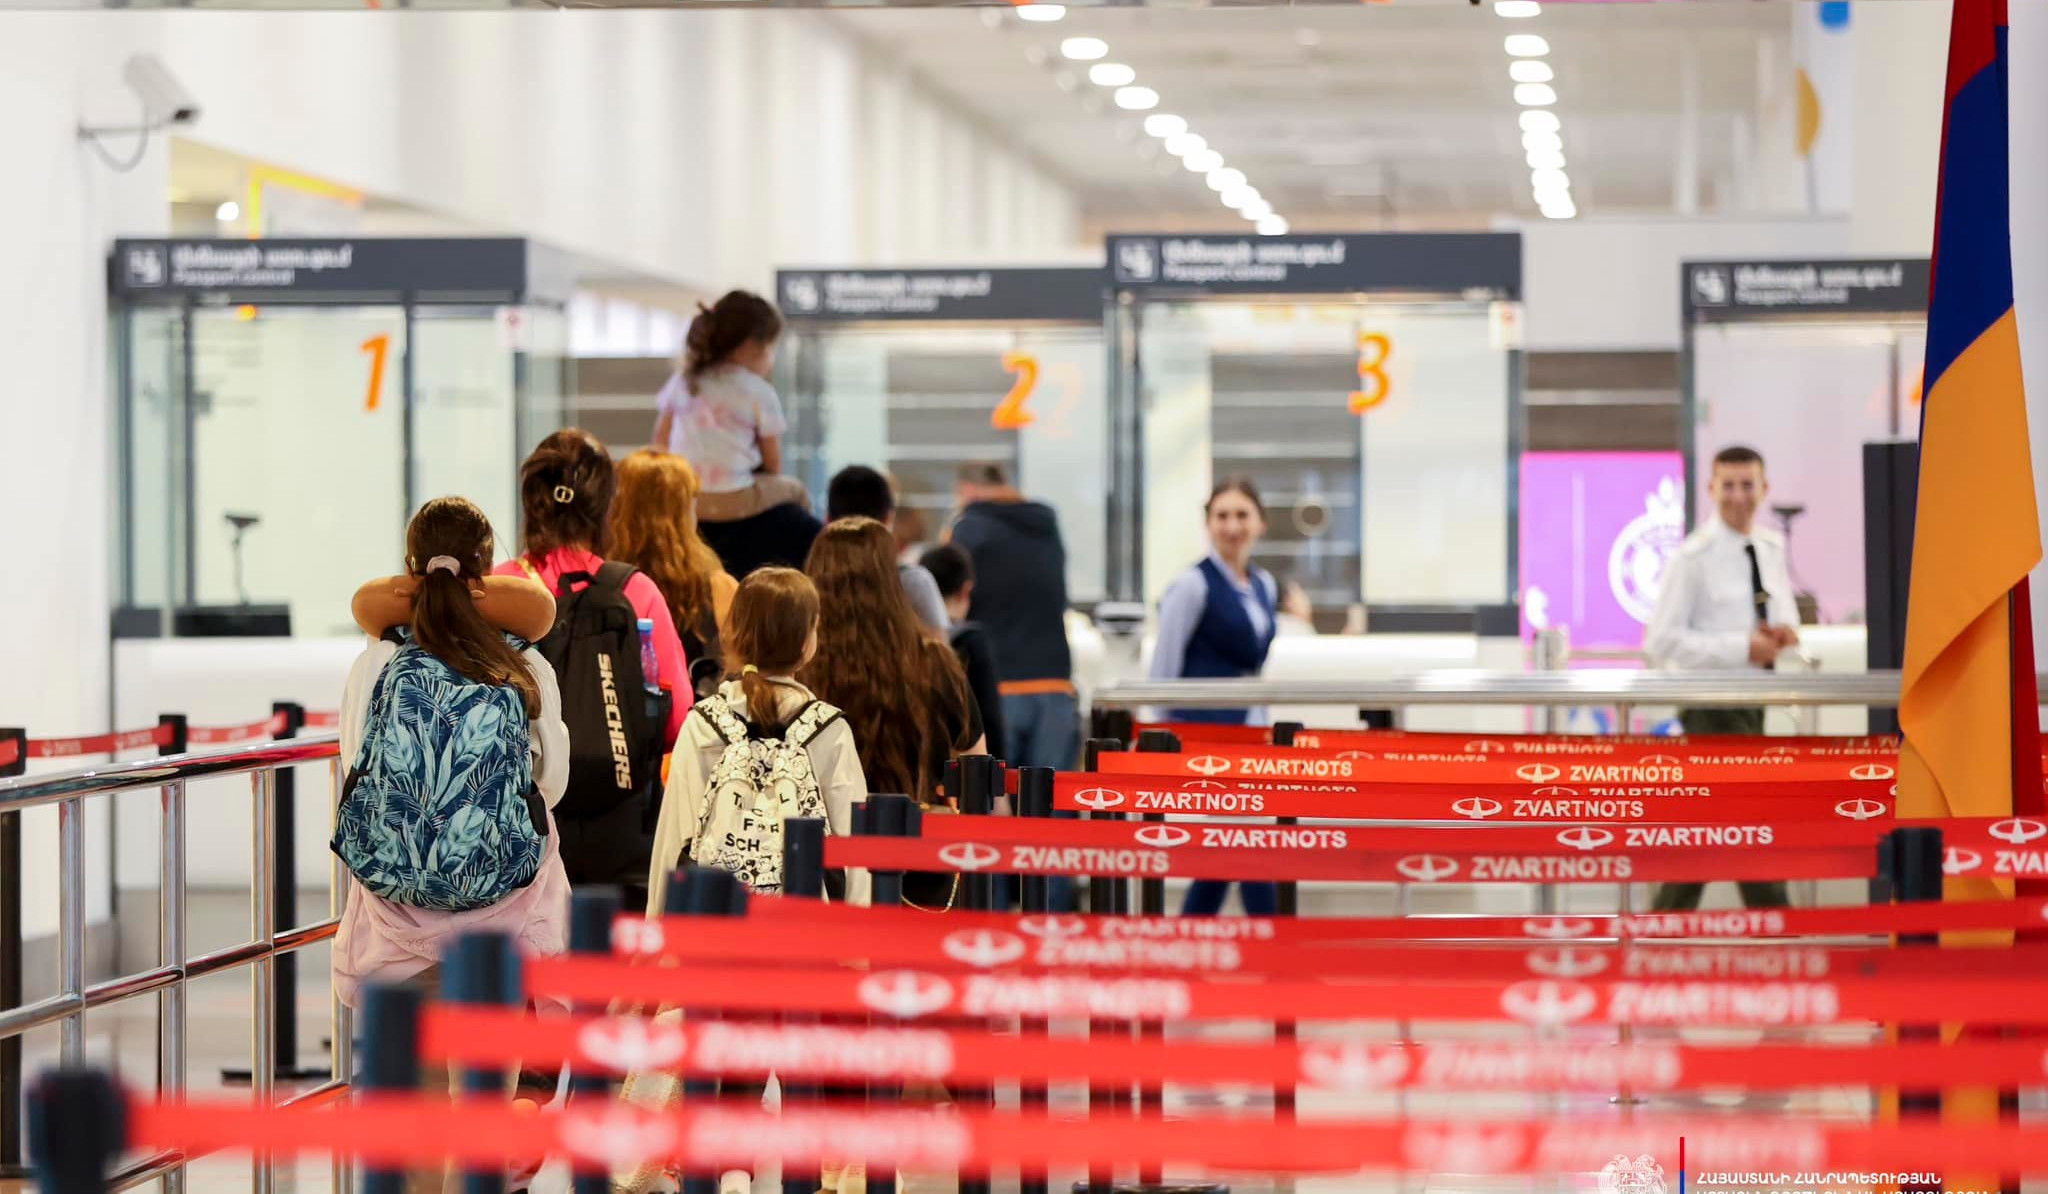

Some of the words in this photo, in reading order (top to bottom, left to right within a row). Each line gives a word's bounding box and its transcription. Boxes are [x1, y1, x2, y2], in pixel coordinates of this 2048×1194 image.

[360, 333, 391, 411] 1
[1348, 331, 1392, 414] 3
[992, 352, 1039, 429] 2
[597, 653, 632, 790] SKECHERS
[1240, 758, 1353, 776] ZVARTNOTS
[1569, 765, 1684, 782] ZVARTNOTS
[1134, 791, 1265, 812] ZVARTNOTS
[1513, 799, 1645, 818] ZVARTNOTS
[1202, 828, 1348, 849] ZVARTNOTS
[1625, 825, 1775, 847] ZVARTNOTS
[1012, 845, 1170, 873] ZVARTNOTS
[1470, 855, 1633, 879] ZVARTNOTS
[1993, 849, 2048, 874] ZVA
[1606, 910, 1786, 937] ZVARTNOTS
